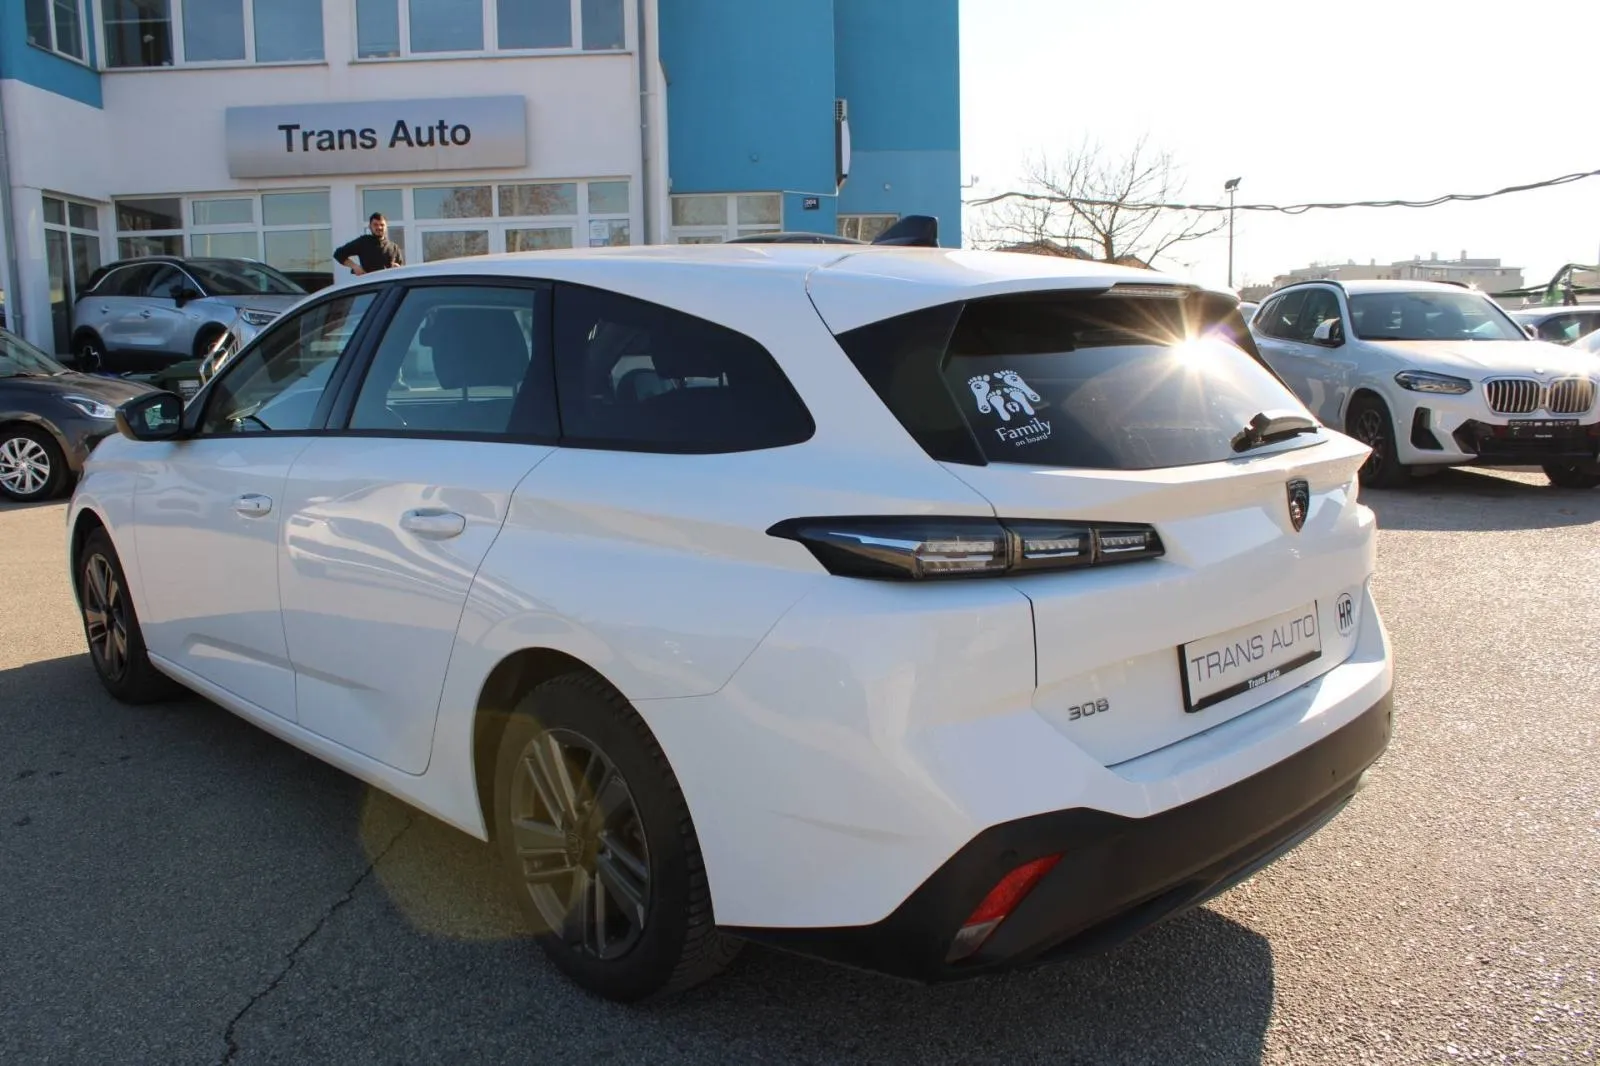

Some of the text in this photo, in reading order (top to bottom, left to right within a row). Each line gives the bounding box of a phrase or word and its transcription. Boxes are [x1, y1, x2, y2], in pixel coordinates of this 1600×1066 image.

[278, 119, 471, 152] Trans Auto
[995, 417, 1051, 442] Family
[1025, 432, 1049, 444] board
[1338, 600, 1354, 630] HR
[1191, 614, 1315, 682] TRANS AUTO
[1248, 669, 1281, 689] Trans Auto
[1068, 698, 1109, 721] 308
